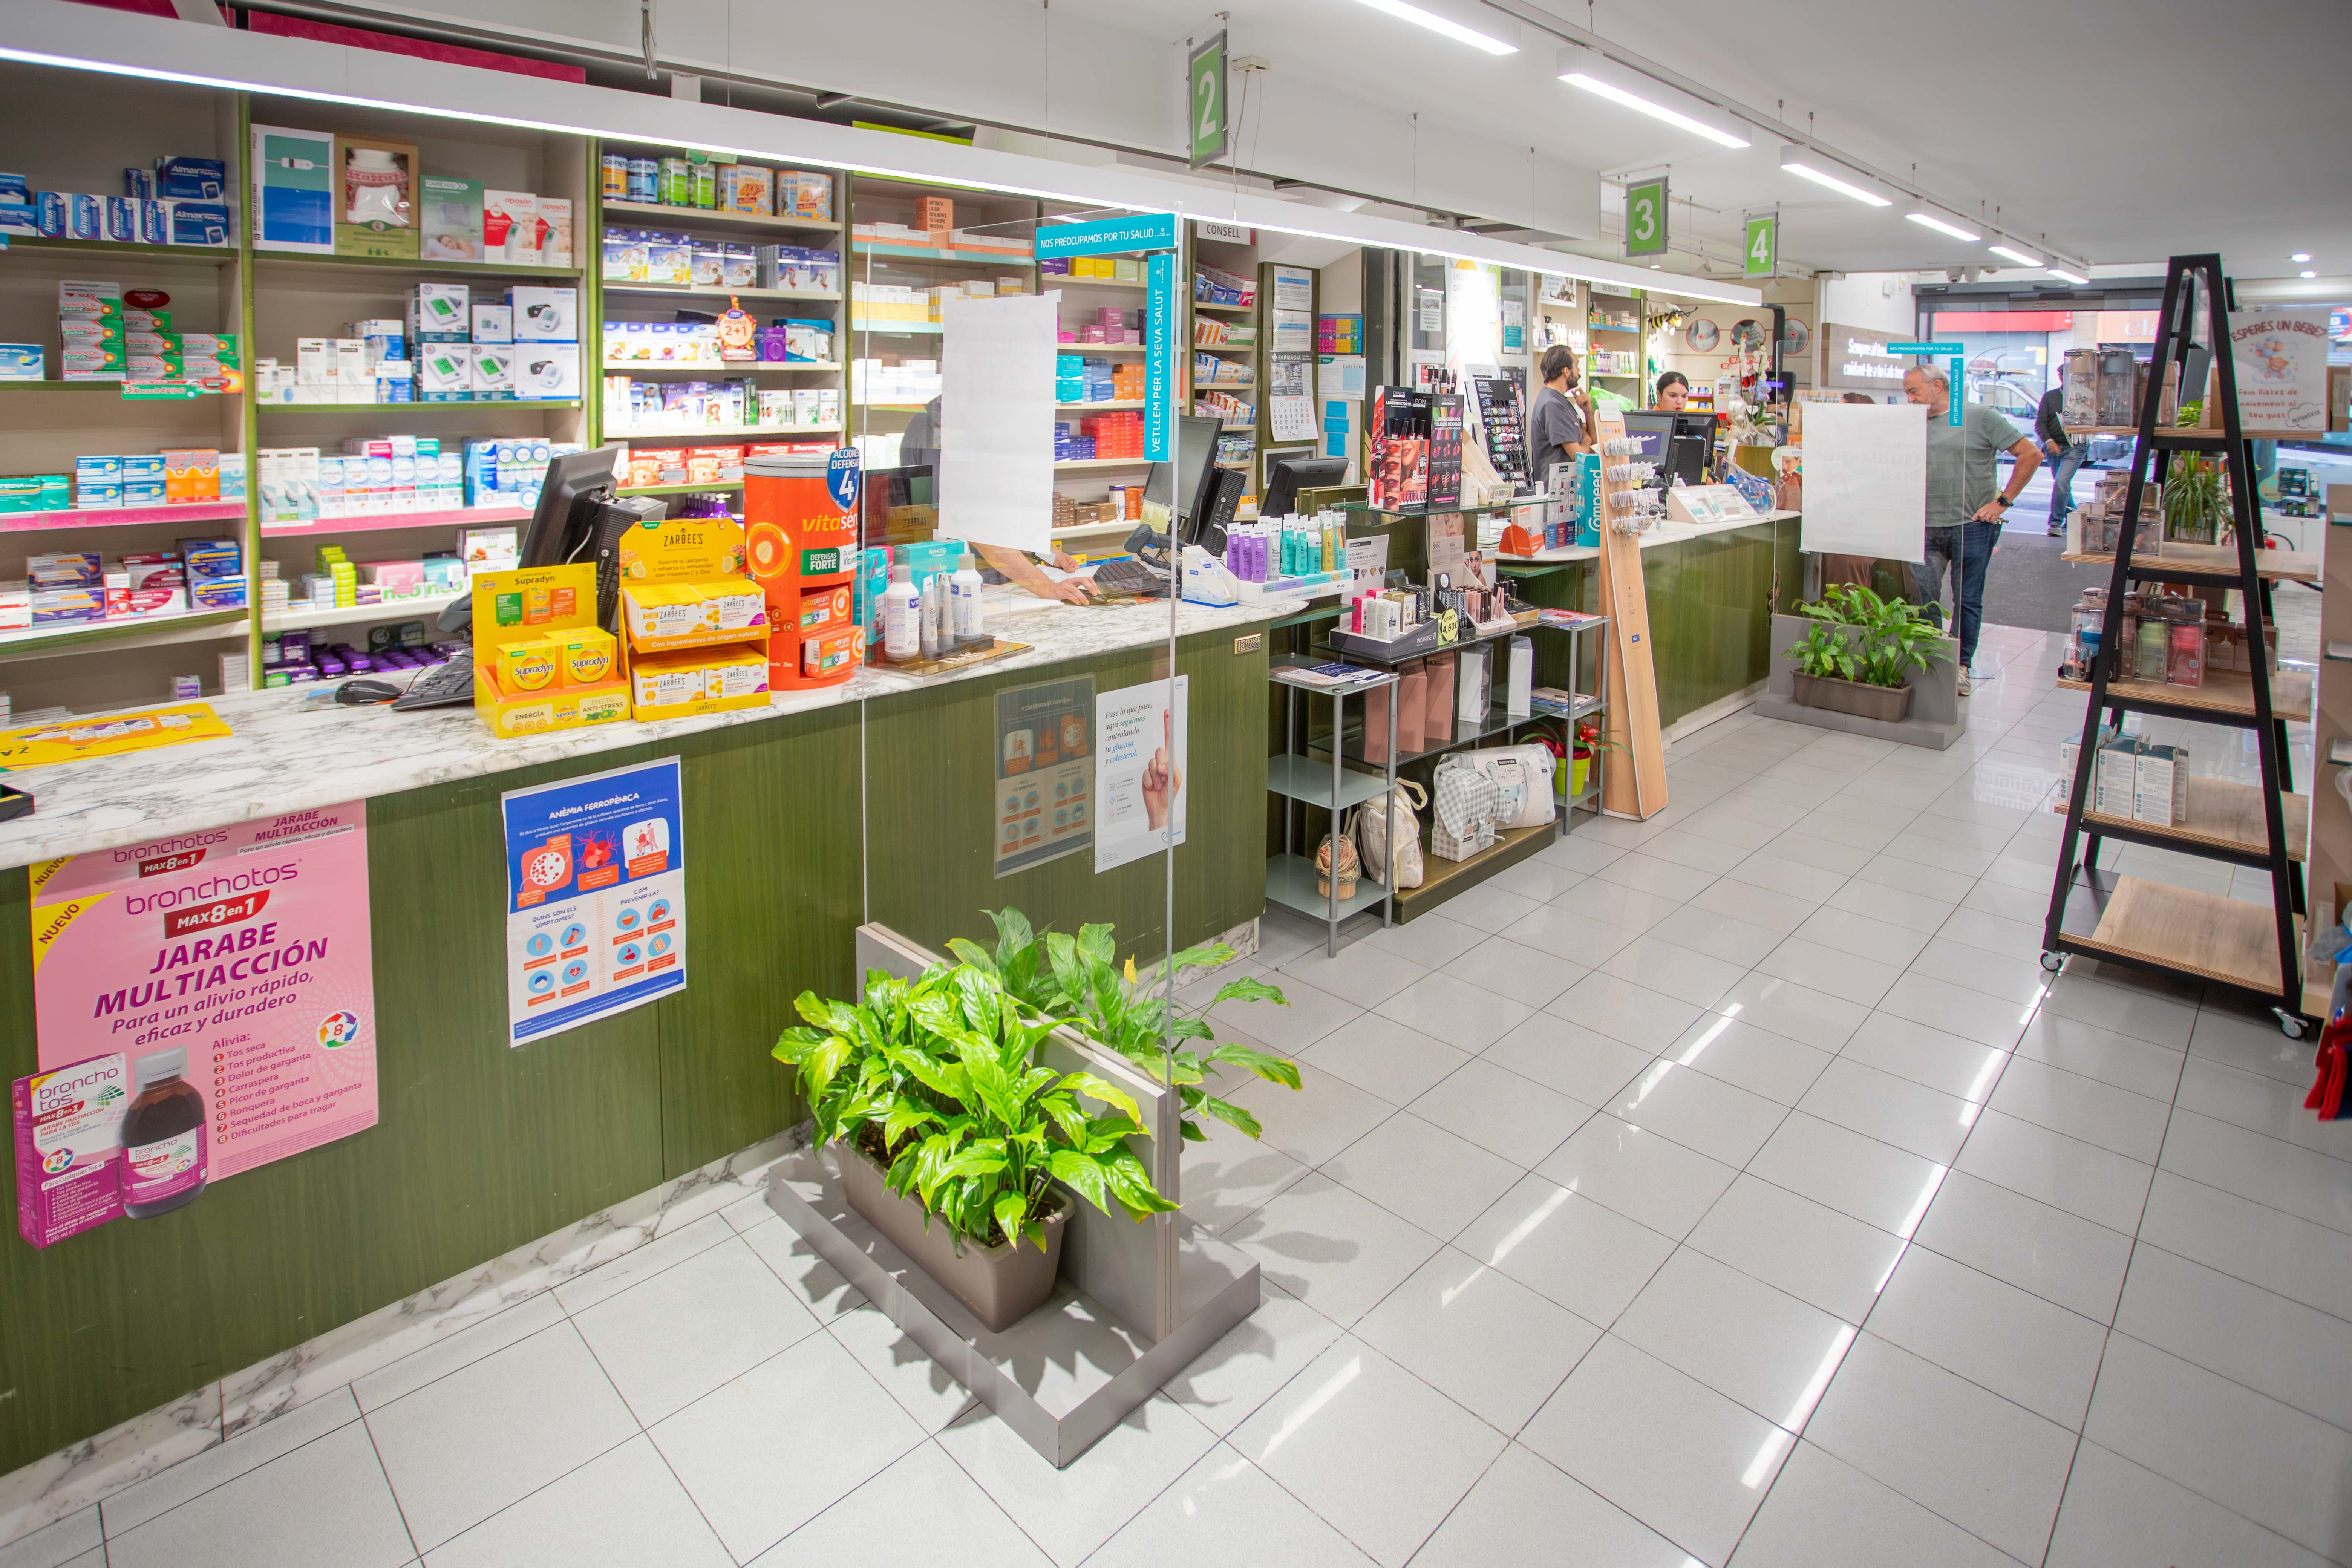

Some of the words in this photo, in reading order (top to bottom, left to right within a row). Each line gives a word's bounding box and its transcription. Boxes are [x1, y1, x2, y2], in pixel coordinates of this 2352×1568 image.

[1199, 70, 1216, 140] 2
[172, 165, 199, 174] Almax
[1635, 199, 1655, 240] 3
[1040, 239, 1053, 248] NOS
[1055, 233, 1102, 247] PREOCUPAMOS
[1104, 232, 1118, 242] POR
[1119, 231, 1129, 240] TU
[1130, 228, 1154, 239] SALUD
[1206, 224, 1240, 239] CONSELL
[1751, 229, 1768, 263] 4
[1155, 289, 1164, 325] SALUT
[725, 326, 747, 337] 2+1
[2230, 320, 2274, 342] ESPERES
[2277, 320, 2291, 331] UN
[1154, 332, 1162, 358] SEVA
[1153, 359, 1162, 375] LA
[1153, 377, 1162, 399] PER
[1152, 402, 1161, 453] VETLLEM
[833, 449, 859, 459] ACCIONES
[831, 458, 859, 469] DEFENSAS
[1412, 470, 1416, 479] 8
[839, 470, 854, 501] 4
[802, 511, 858, 532] vitasér
[663, 533, 704, 547] ZARBEE'S
[810, 553, 837, 561] DEFENSAS
[810, 559, 837, 571] FORTE
[515, 575, 556, 585] Supradyn
[1442, 621, 1458, 634] 4,50€
[666, 637, 706, 648] ingredientes
[717, 634, 737, 642] origen
[1416, 635, 1433, 644] INCAROSE
[571, 655, 609, 668] Supradyn
[583, 701, 623, 713] ANTI-STRESS
[591, 697, 614, 705] EFECTO
[515, 710, 545, 720] ENERGÍA
[1106, 710, 1119, 719] Pase
[1120, 707, 1125, 716] lo
[1127, 706, 1137, 716] que
[1138, 703, 1152, 713] pase,
[1105, 720, 1119, 731] aquí
[1119, 715, 1145, 728] seguimos
[1105, 727, 1139, 741] controlando
[1112, 740, 1134, 753] glucosa
[1109, 749, 1138, 764] colesterol.
[549, 804, 583, 820] ANÈMIA
[584, 792, 640, 812] FERROPÈNICA
[114, 831, 228, 863] bronchotos
[33, 857, 66, 886] NUEVO
[126, 863, 298, 915] bronchotos
[620, 890, 660, 906] PREVENIR-LA?
[633, 886, 648, 895] COM
[532, 911, 551, 923] QUINS
[551, 907, 566, 919] SÓN
[567, 905, 577, 914] ELS
[534, 913, 575, 929] SÍMPTOMES?
[38, 903, 80, 945] NUEVO
[149, 922, 277, 975] JARABE
[93, 937, 328, 1019] MULTIACCIÓN
[112, 1012, 159, 1034] Para
[165, 1005, 188, 1019] un
[193, 989, 246, 1012] alivio
[250, 970, 314, 998] rápido,
[135, 1021, 192, 1046] eficaz
[196, 1017, 208, 1033] y
[211, 992, 296, 1025] duradero
[212, 1032, 251, 1050] Alivia:
[227, 1050, 245, 1058] Tos
[246, 1043, 266, 1054] seca
[228, 1062, 244, 1070] Tos
[246, 1045, 296, 1067] productiva
[228, 1070, 254, 1082] Dolor
[256, 1064, 268, 1073] de
[270, 1052, 311, 1071] garganta
[39, 1068, 118, 1099] broncho
[228, 1073, 279, 1093] Carraspera
[230, 1093, 254, 1105] Picor
[255, 1088, 267, 1097] de
[269, 1076, 310, 1095] garganta
[40, 1093, 73, 1112] tos
[230, 1098, 276, 1117] Ronquera
[231, 1109, 277, 1129] Sequedad
[279, 1104, 291, 1113] de
[292, 1097, 314, 1109] boca
[316, 1095, 322, 1103] y
[323, 1082, 363, 1101] garganta
[231, 1119, 286, 1140] Dificultades
[288, 1110, 308, 1124] para
[309, 1101, 337, 1116] tragar
